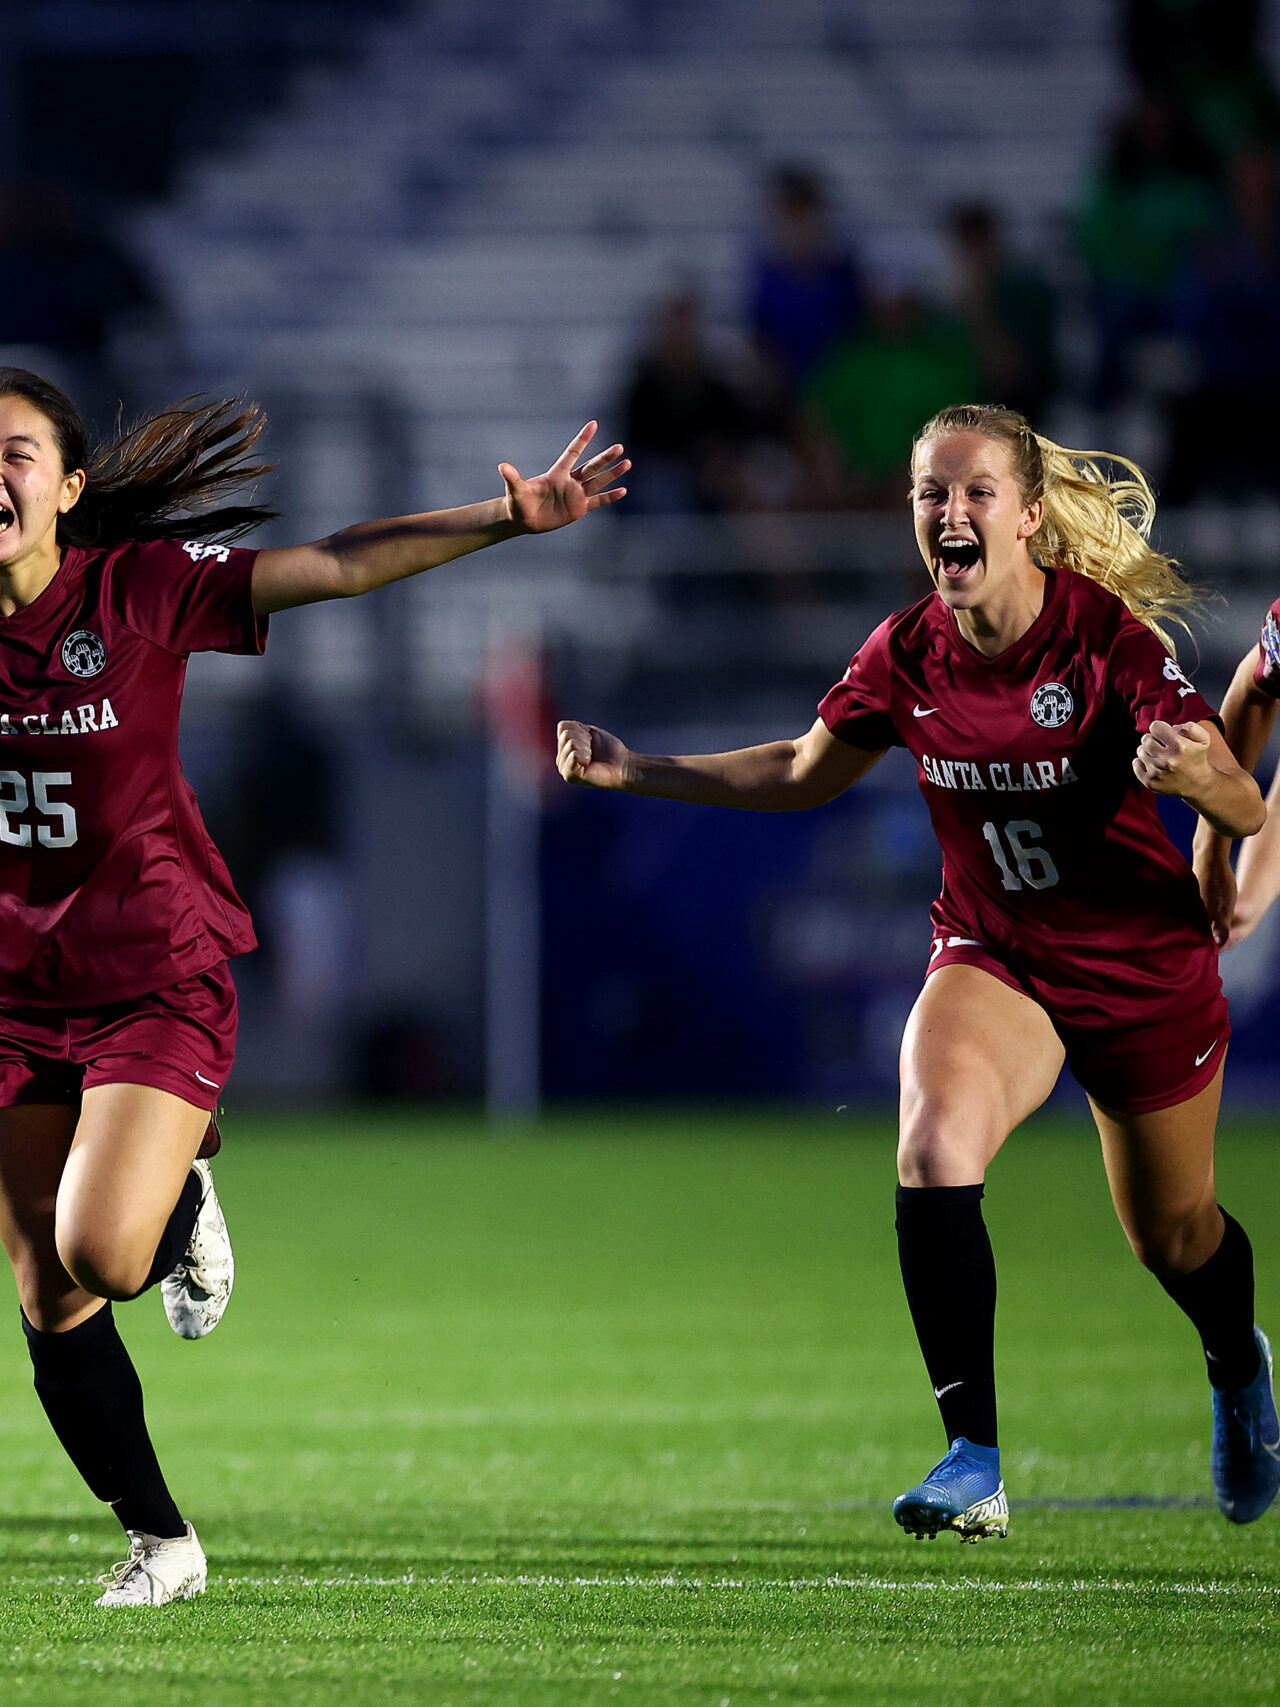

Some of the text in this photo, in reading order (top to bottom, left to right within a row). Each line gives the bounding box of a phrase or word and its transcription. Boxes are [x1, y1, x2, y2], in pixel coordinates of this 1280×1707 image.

[22, 697, 119, 735] CLARA
[922, 753, 1080, 792] SANTA CLARA
[982, 819, 1060, 892] 16
